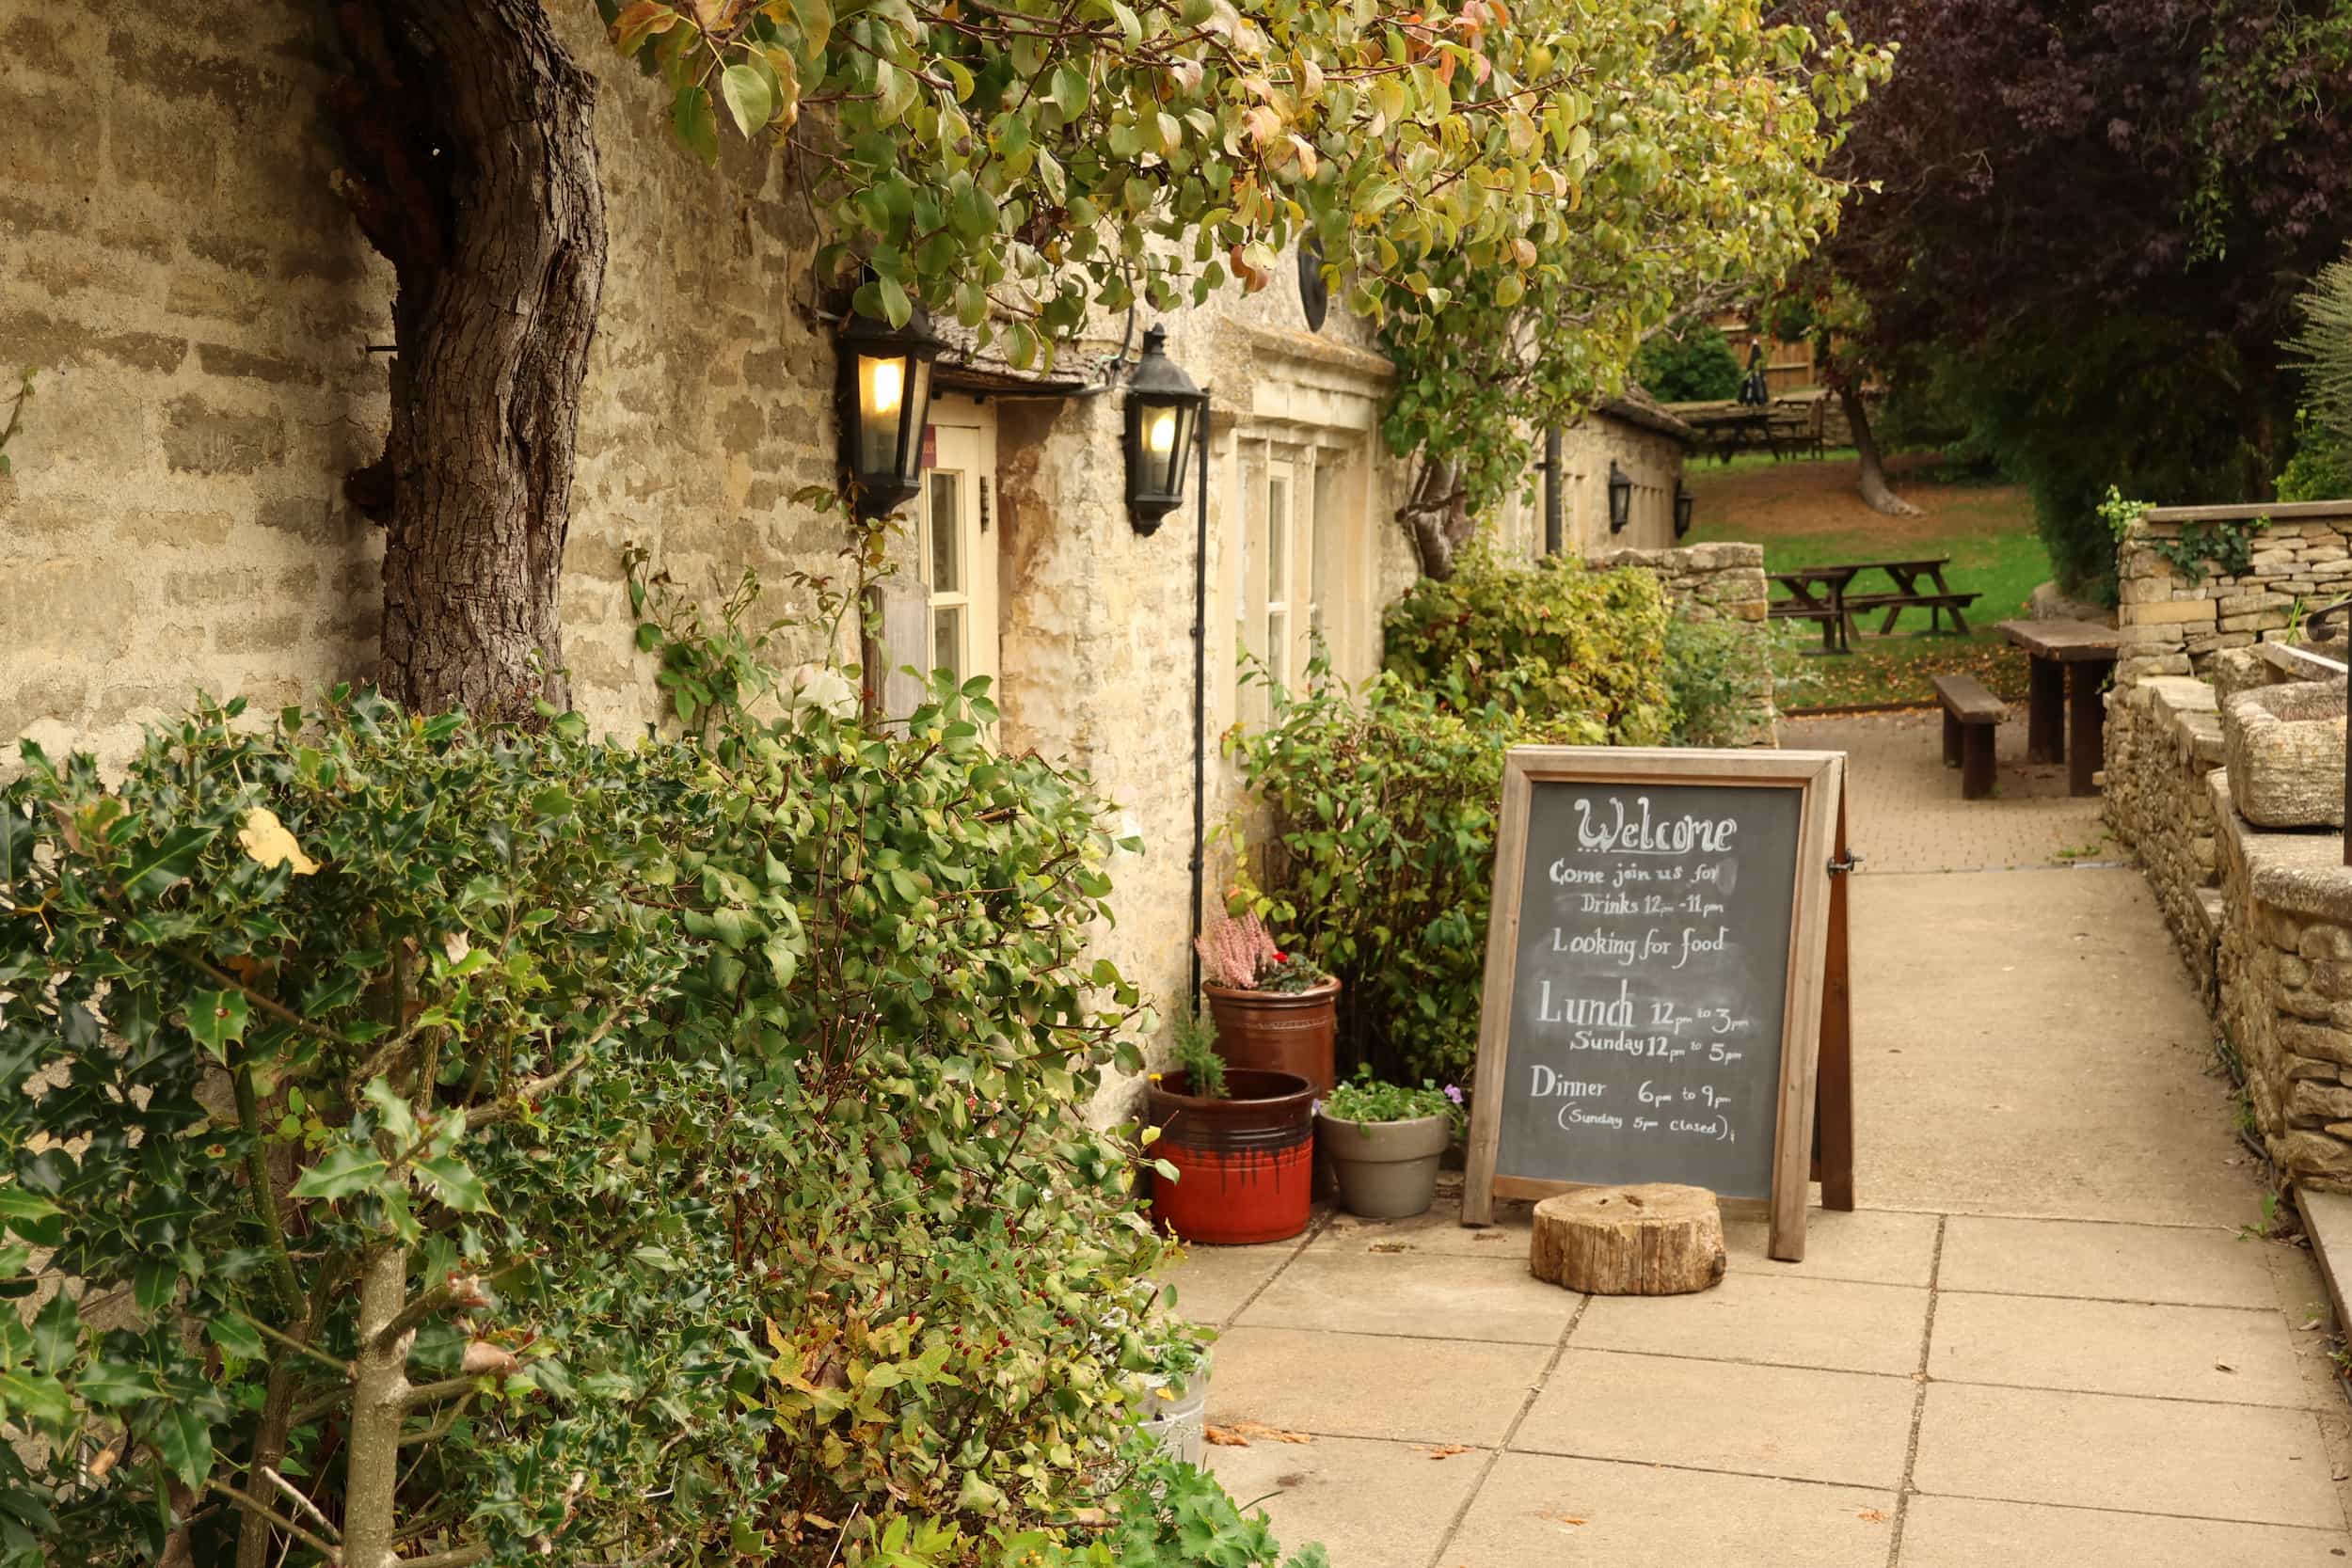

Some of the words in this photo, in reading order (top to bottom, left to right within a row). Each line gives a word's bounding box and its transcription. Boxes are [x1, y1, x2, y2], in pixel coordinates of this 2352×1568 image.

[1574, 797, 1738, 852] Welcome
[1549, 858, 1605, 885] Come
[1613, 863, 1651, 888] join
[1656, 865, 1683, 880] us
[1690, 863, 1719, 884] for
[1581, 892, 1639, 914] Drinks
[1552, 927, 1636, 966] Looking
[1639, 928, 1672, 960] for
[1671, 926, 1730, 970] food
[1535, 978, 1637, 1027] Lunch
[1650, 1002, 1692, 1035] 12pm
[1697, 1007, 1710, 1018] to
[1711, 1007, 1749, 1034] 3pm
[1569, 1030, 1644, 1055] Sunday
[1646, 1037, 1686, 1063] 12pm
[1691, 1040, 1702, 1051] to
[1708, 1042, 1742, 1066] 5pm
[1530, 1065, 1607, 1097] Dinner
[1638, 1080, 1672, 1108] 6pm
[1682, 1086, 1696, 1101] to
[1701, 1085, 1731, 1109] 9pm
[1558, 1101, 1623, 1131] (Sunday
[1633, 1117, 1659, 1132] 5pm
